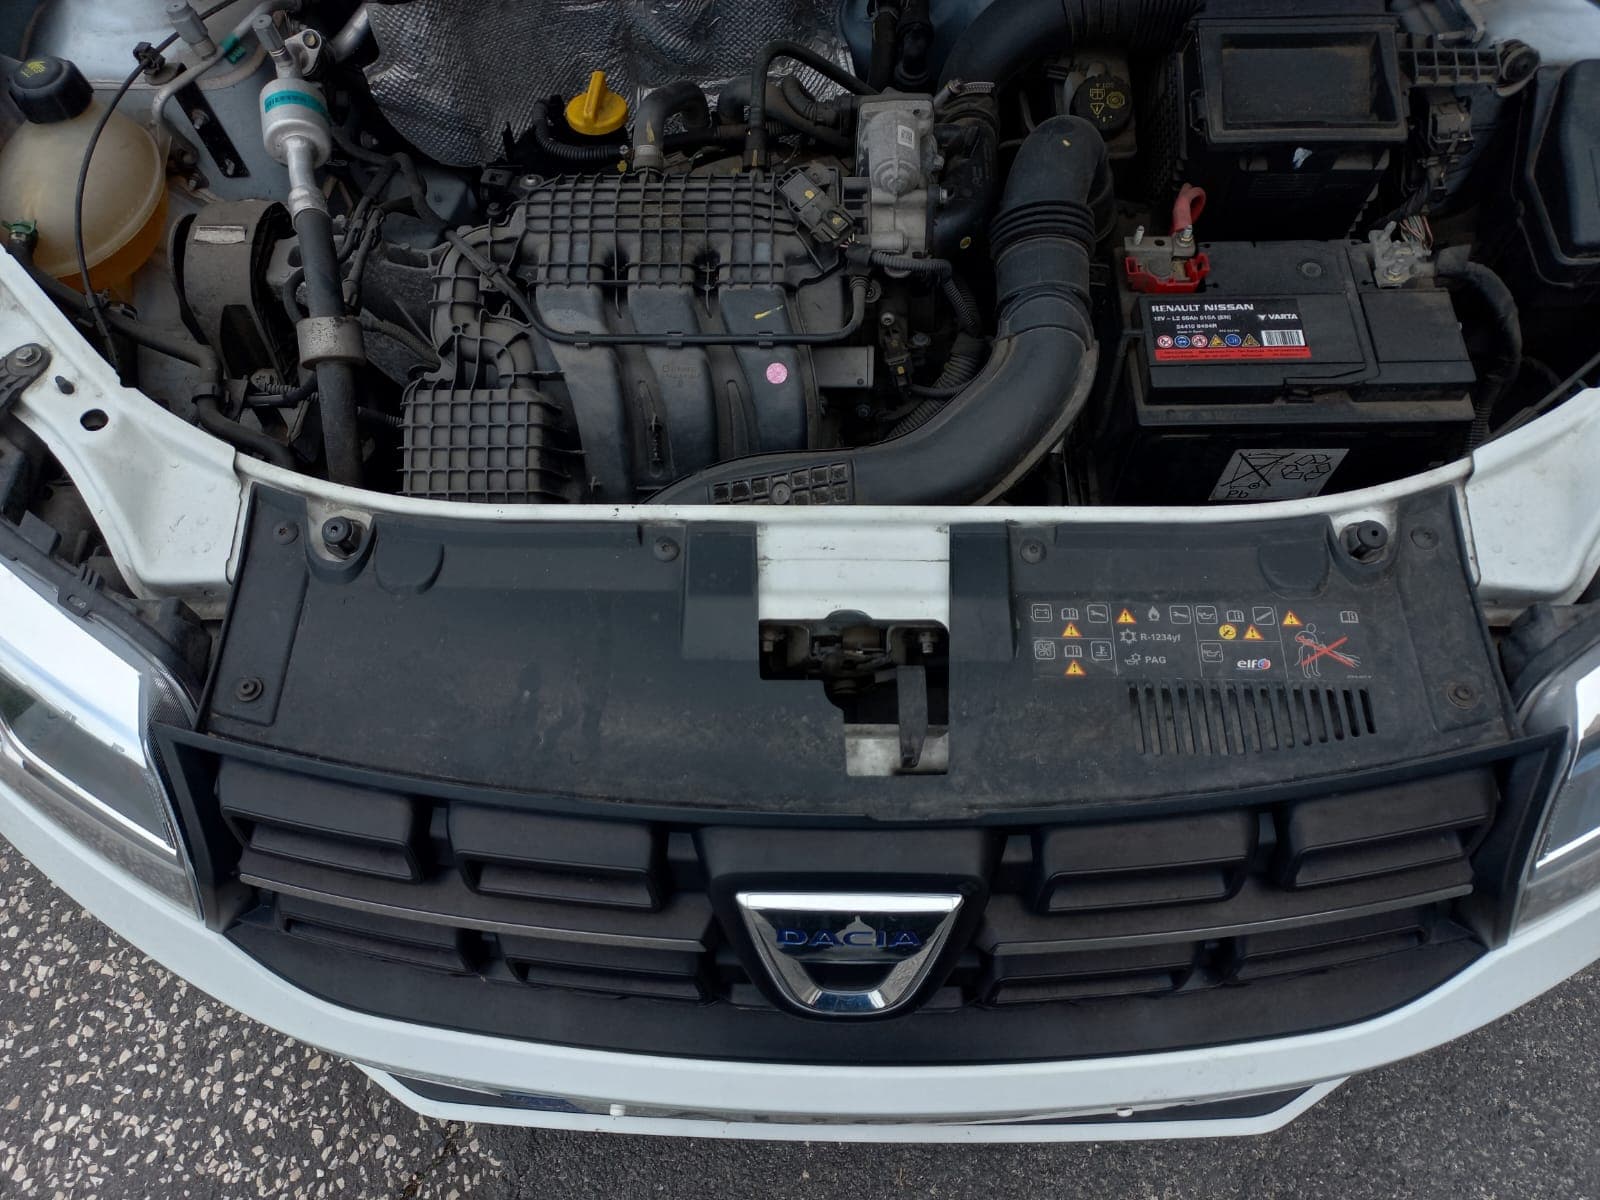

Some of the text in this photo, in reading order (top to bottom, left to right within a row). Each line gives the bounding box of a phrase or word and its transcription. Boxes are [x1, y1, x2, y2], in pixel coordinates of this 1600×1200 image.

[1151, 303, 1254, 312] RENAULT NISSAN
[1226, 489, 1249, 498] Pb
[1140, 632, 1181, 643] R-1234yf
[1144, 655, 1167, 664] PAG
[1236, 659, 1258, 669] elf
[776, 928, 922, 948] DACIA
